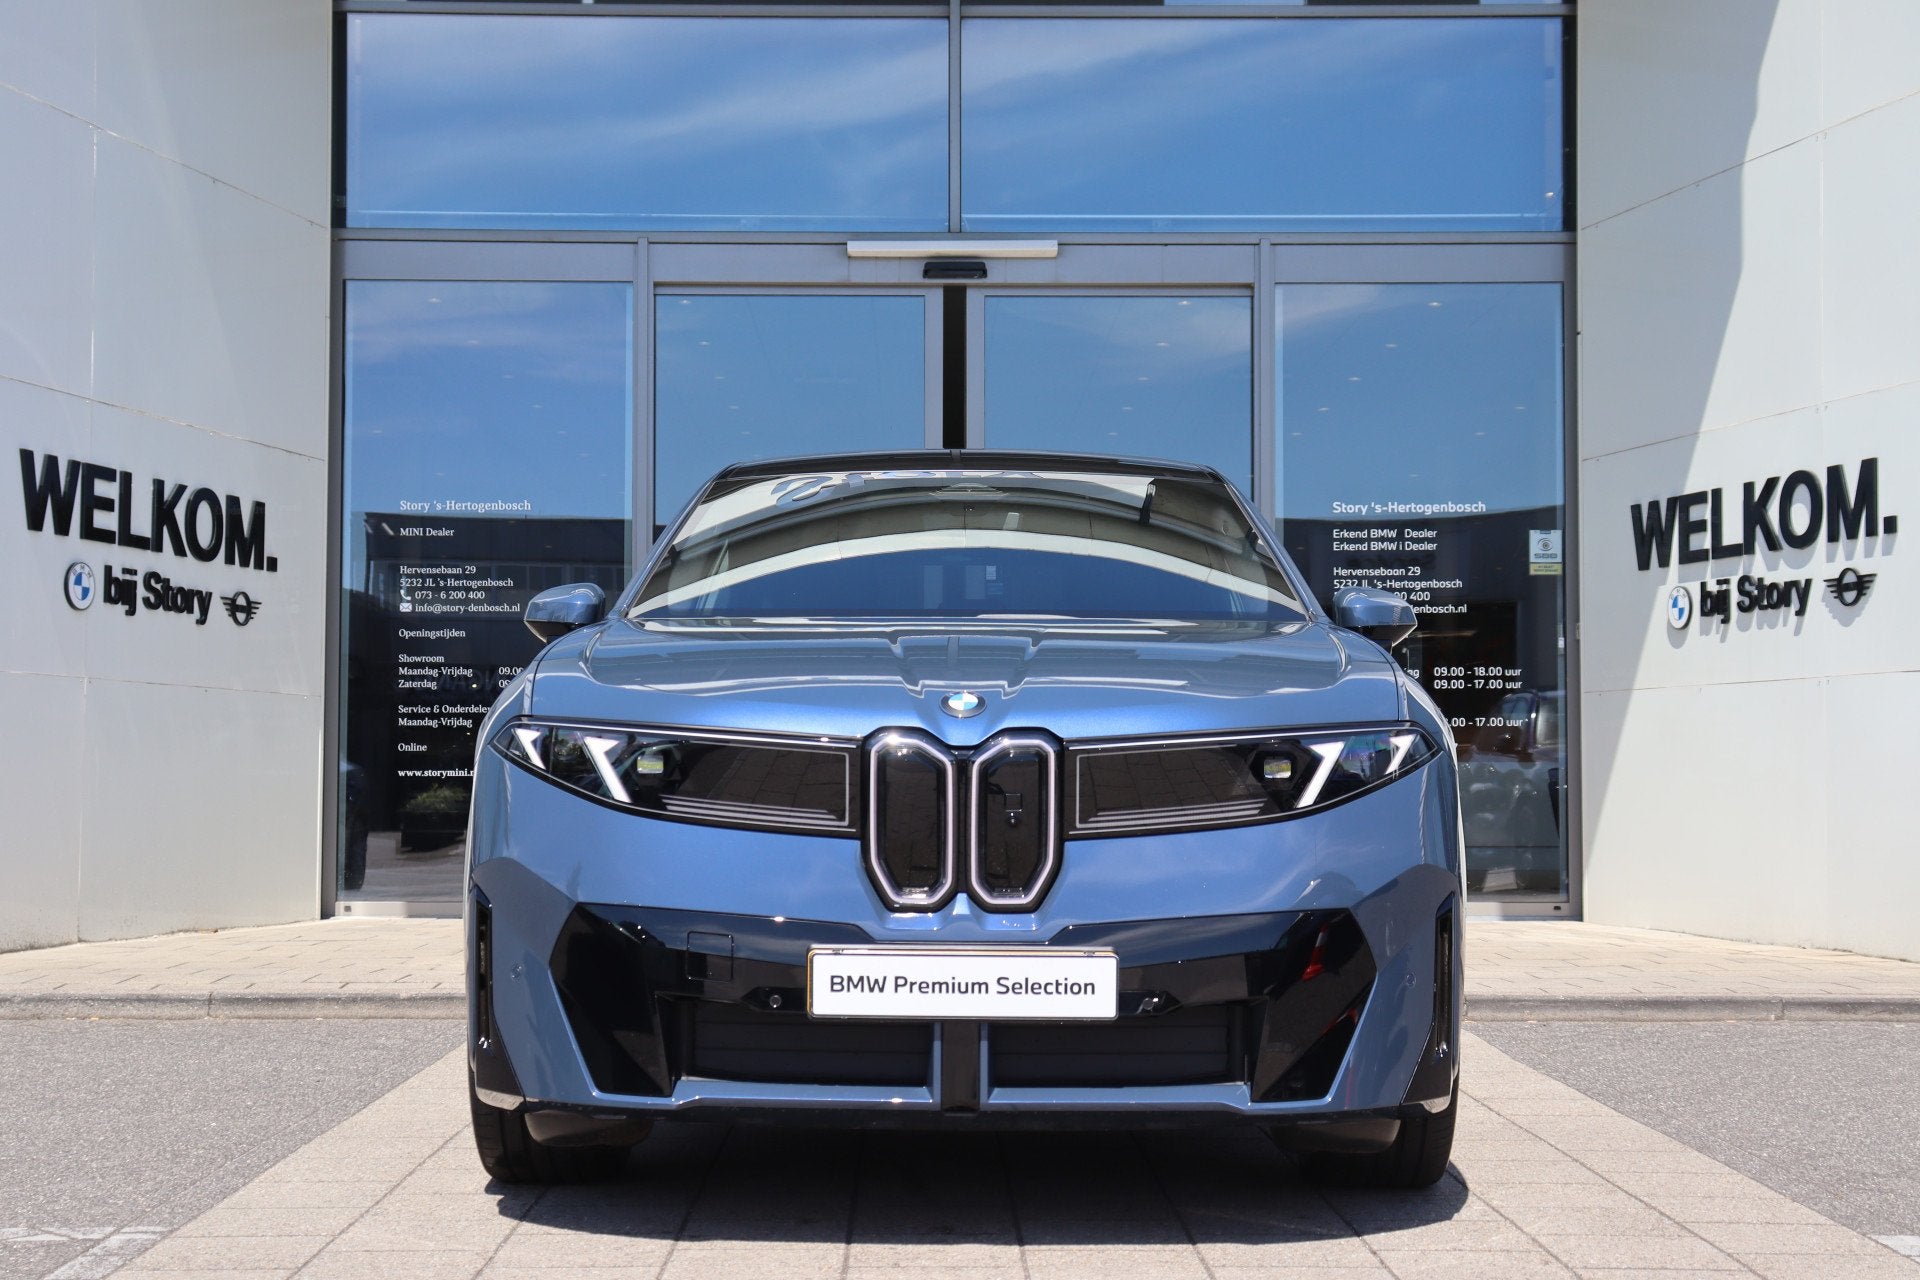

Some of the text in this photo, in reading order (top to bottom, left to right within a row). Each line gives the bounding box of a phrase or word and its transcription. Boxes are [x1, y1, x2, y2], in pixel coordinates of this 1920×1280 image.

[19, 448, 277, 573] WELKOM.
[400, 500, 531, 511] Story 's-Hertogenbosch
[1333, 501, 1486, 515] Story 's-Hertogenbosch
[1630, 457, 1898, 571] WELKOM.
[400, 528, 455, 536] MINI Dealer
[1333, 529, 1437, 539] Erkend BMW Dealer
[1333, 542, 1368, 551] Erkend
[1370, 542, 1398, 551] BMW
[1405, 542, 1437, 551] Dealer
[400, 566, 476, 574] Hervensebaan 29
[1334, 567, 1421, 576] Hervensebaan 29
[400, 578, 513, 589] 5232 JL 's-Hertogenbosch
[1374, 579, 1462, 590] 's-Hertogenbosch
[104, 565, 212, 626] bij Story
[415, 591, 432, 599] 073
[440, 591, 447, 599] 6
[449, 591, 466, 599] 200
[468, 591, 485, 599] 400
[1410, 592, 1431, 601] 400
[1700, 575, 1813, 625] bij Story
[415, 603, 520, 614] info@story-denbosch.nl
[399, 629, 466, 639] Openingstijden
[398, 654, 445, 663] Showroom
[398, 667, 473, 677] Maandag-Vrijdag
[1434, 667, 1465, 677] 09.00
[1474, 667, 1503, 677] 18.00
[1505, 669, 1522, 677] uur
[398, 680, 437, 690] Zaterdag
[1434, 680, 1465, 689] 09.00
[398, 705, 431, 713] Service
[433, 705, 440, 713] &
[398, 718, 473, 728] Maandag-Vrijdag
[398, 743, 427, 752] Online
[830, 975, 1095, 996] BMW Premium Selection
